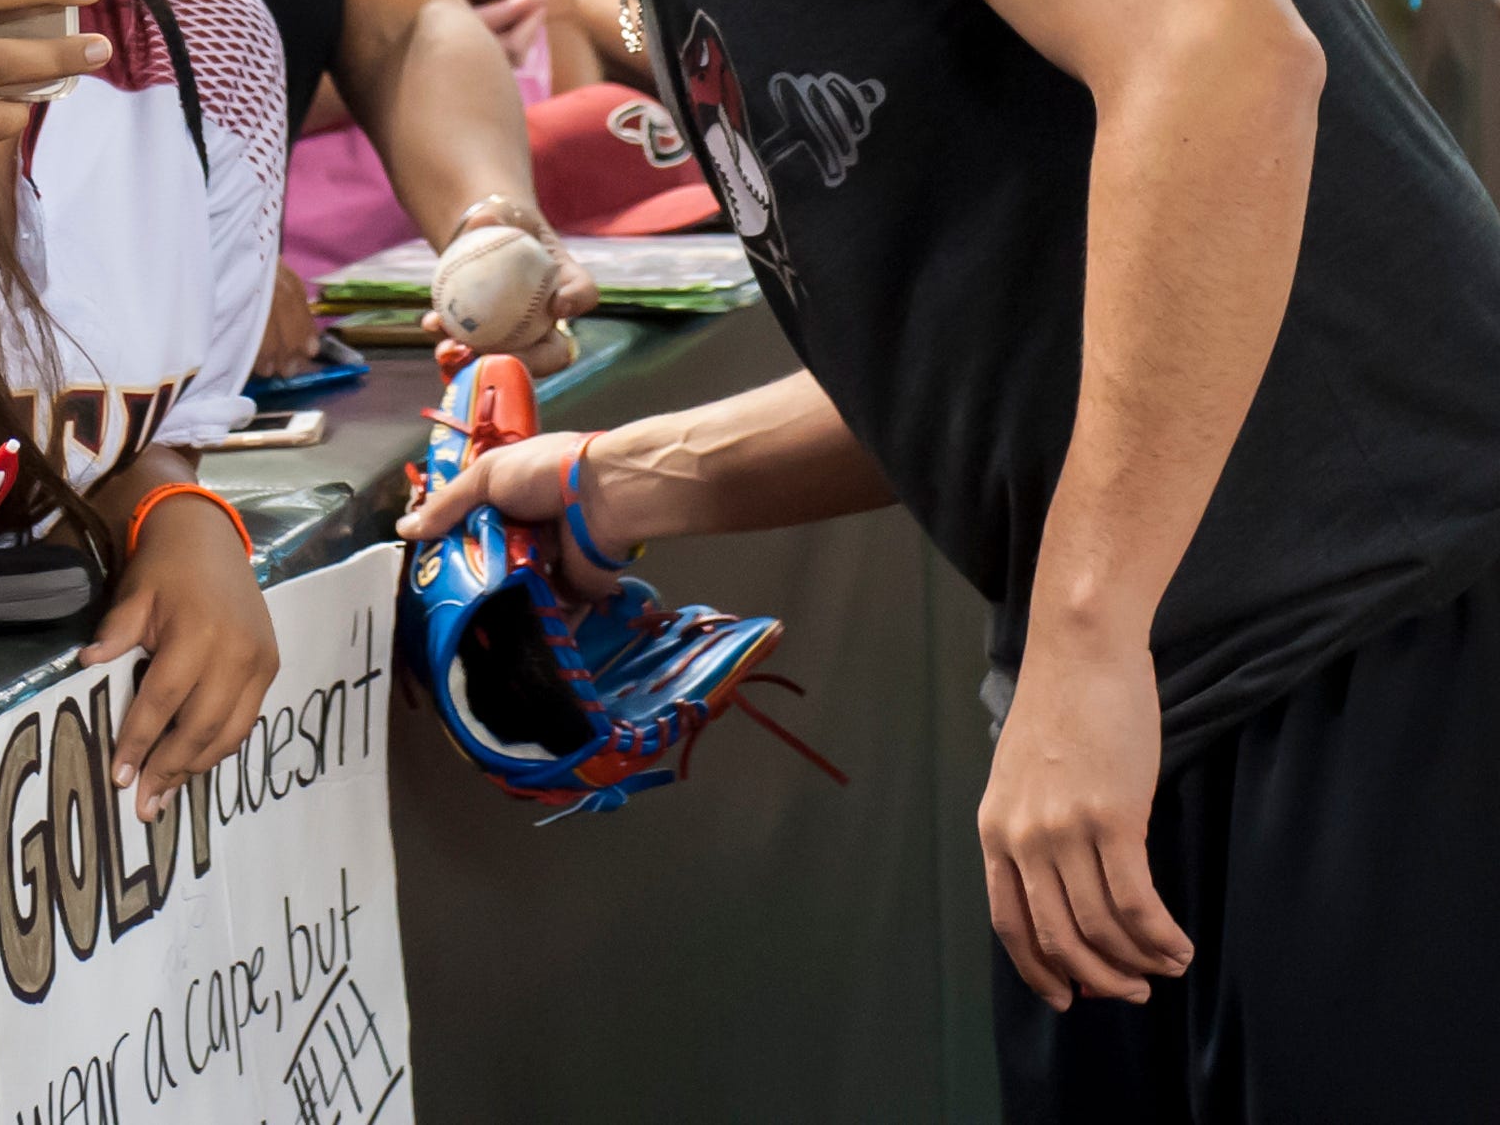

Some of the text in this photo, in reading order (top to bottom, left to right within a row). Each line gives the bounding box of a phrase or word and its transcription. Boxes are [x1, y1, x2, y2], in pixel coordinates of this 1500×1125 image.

[144, 1008, 178, 1105] a
[185, 946, 282, 1075] cape,
[284, 868, 360, 1001] but
